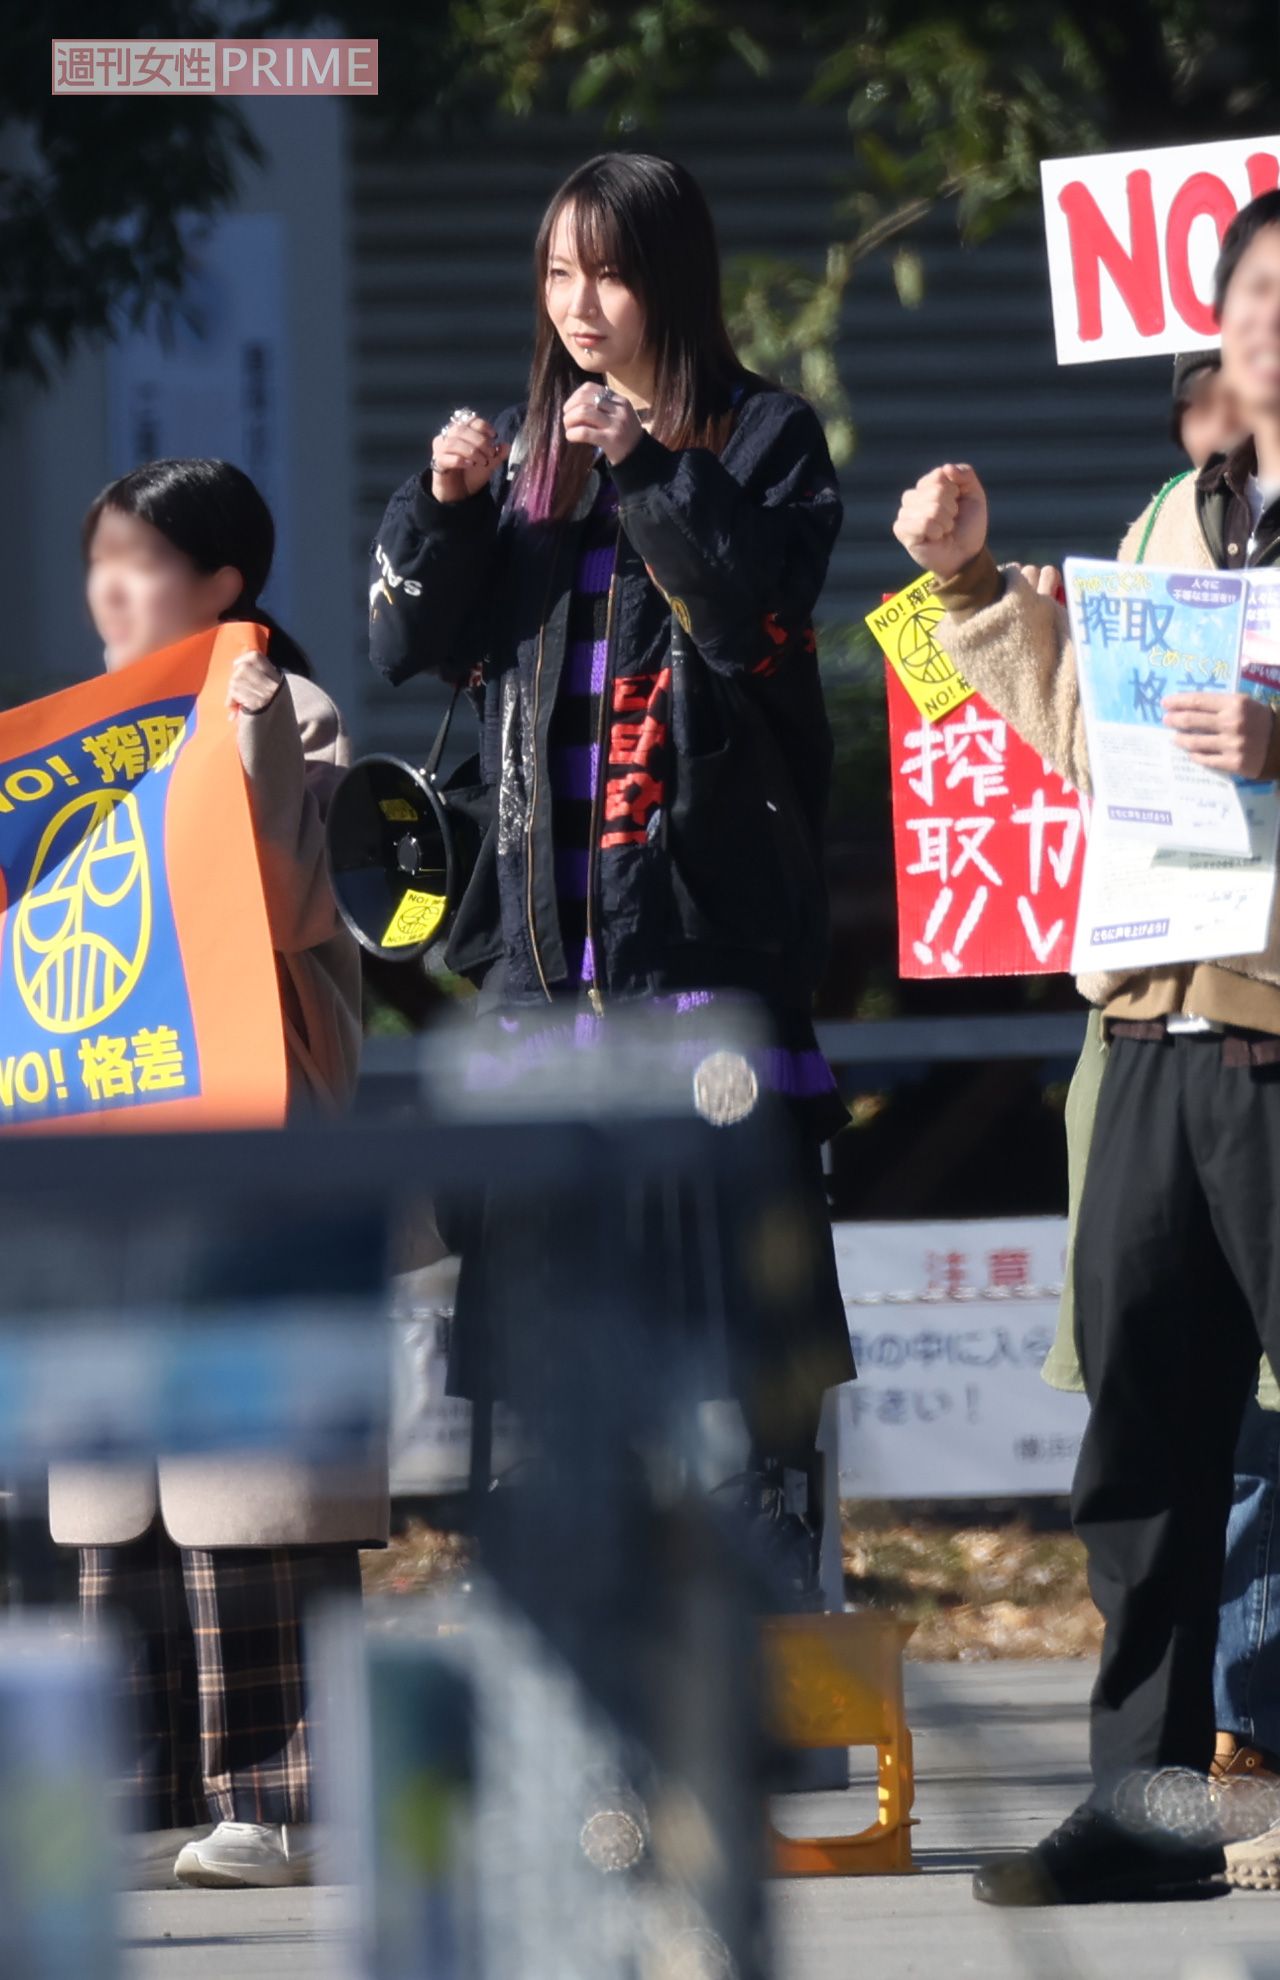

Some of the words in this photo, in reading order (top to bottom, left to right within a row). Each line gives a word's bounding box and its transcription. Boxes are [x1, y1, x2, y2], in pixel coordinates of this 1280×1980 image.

[874, 602, 907, 632] NO!
[1079, 589, 1175, 653] 搾取
[924, 686, 957, 716] NO!
[81, 715, 187, 784] 搾取
[78, 1025, 186, 1101] 格差
